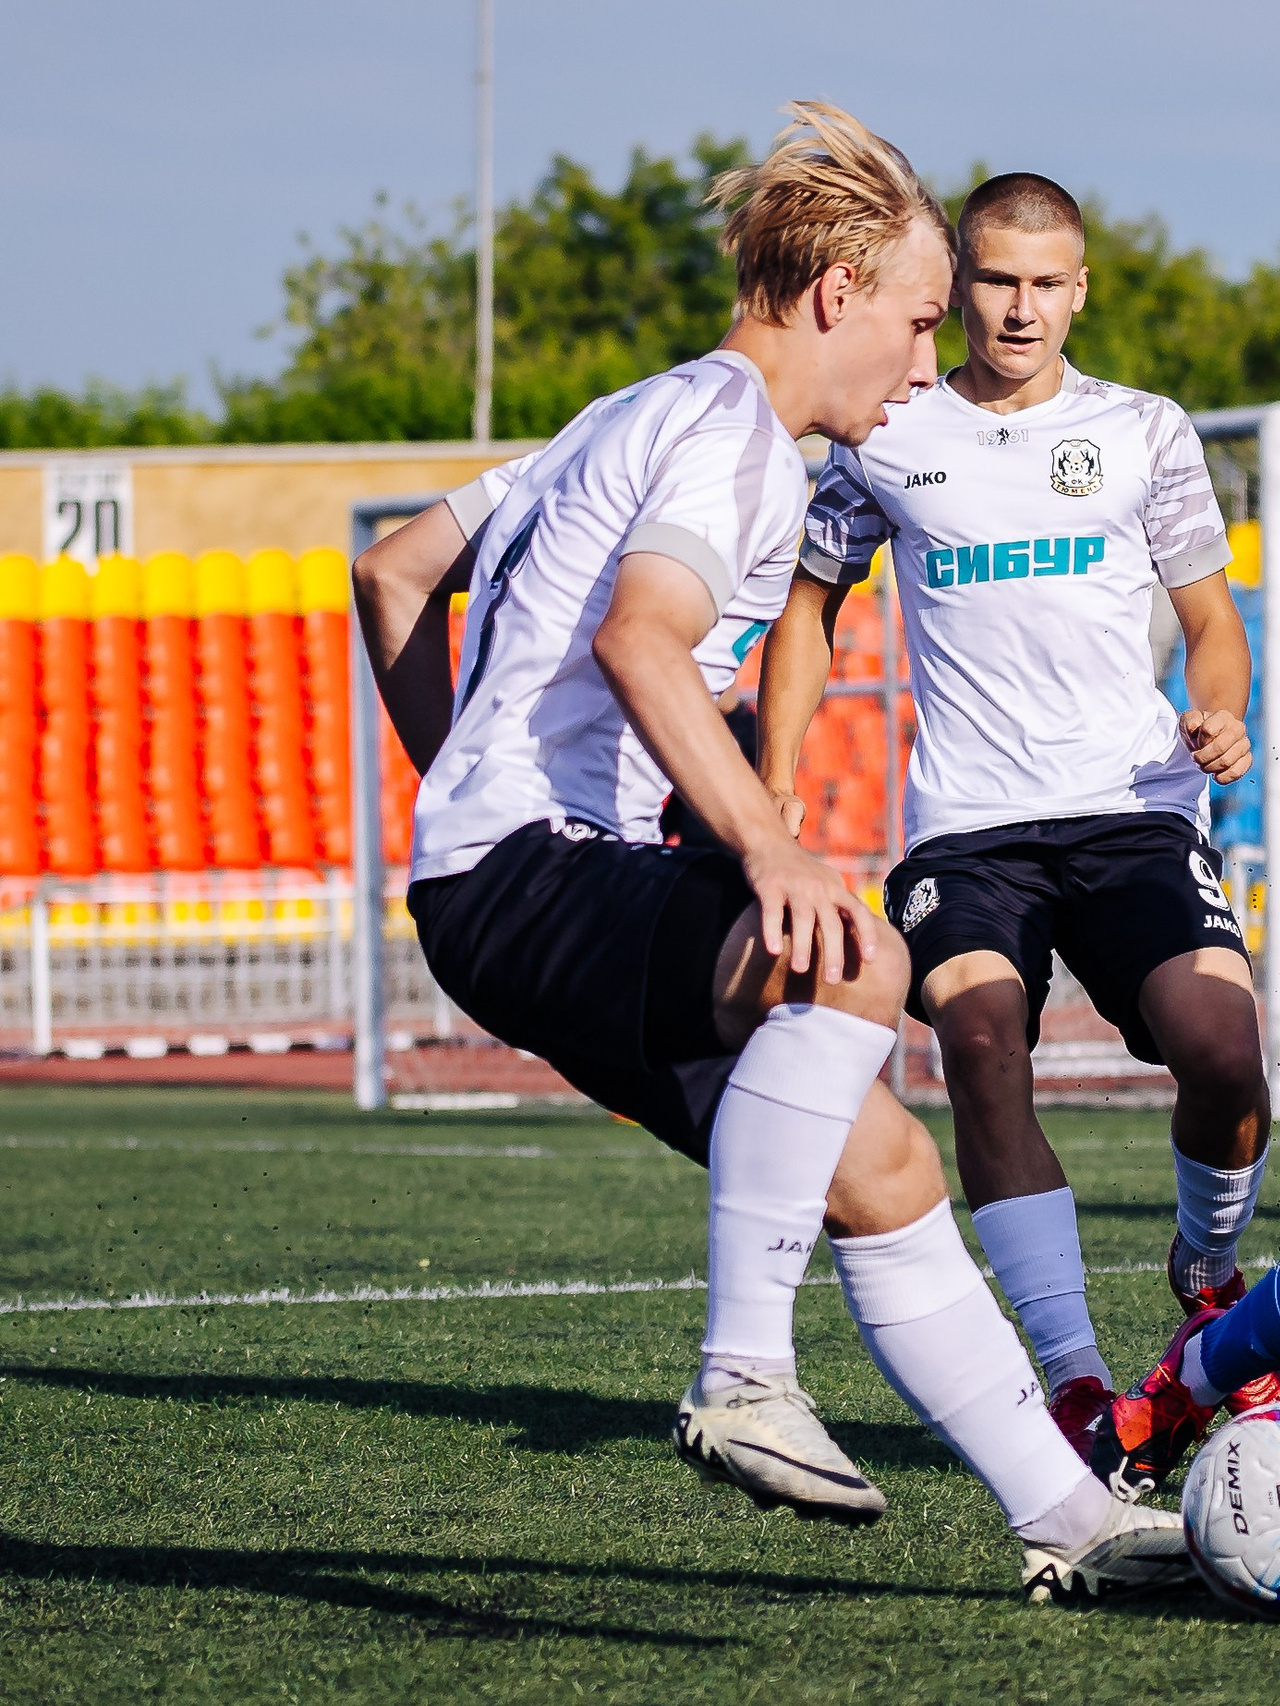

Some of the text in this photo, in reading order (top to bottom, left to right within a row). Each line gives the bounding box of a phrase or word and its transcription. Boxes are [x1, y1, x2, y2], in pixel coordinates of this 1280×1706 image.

[904, 471, 947, 489] JAKO
[58, 500, 119, 556] 20
[926, 536, 1105, 588] СИБУР
[1189, 851, 1230, 911] 9
[1227, 1440, 1249, 1536] DEMIX
